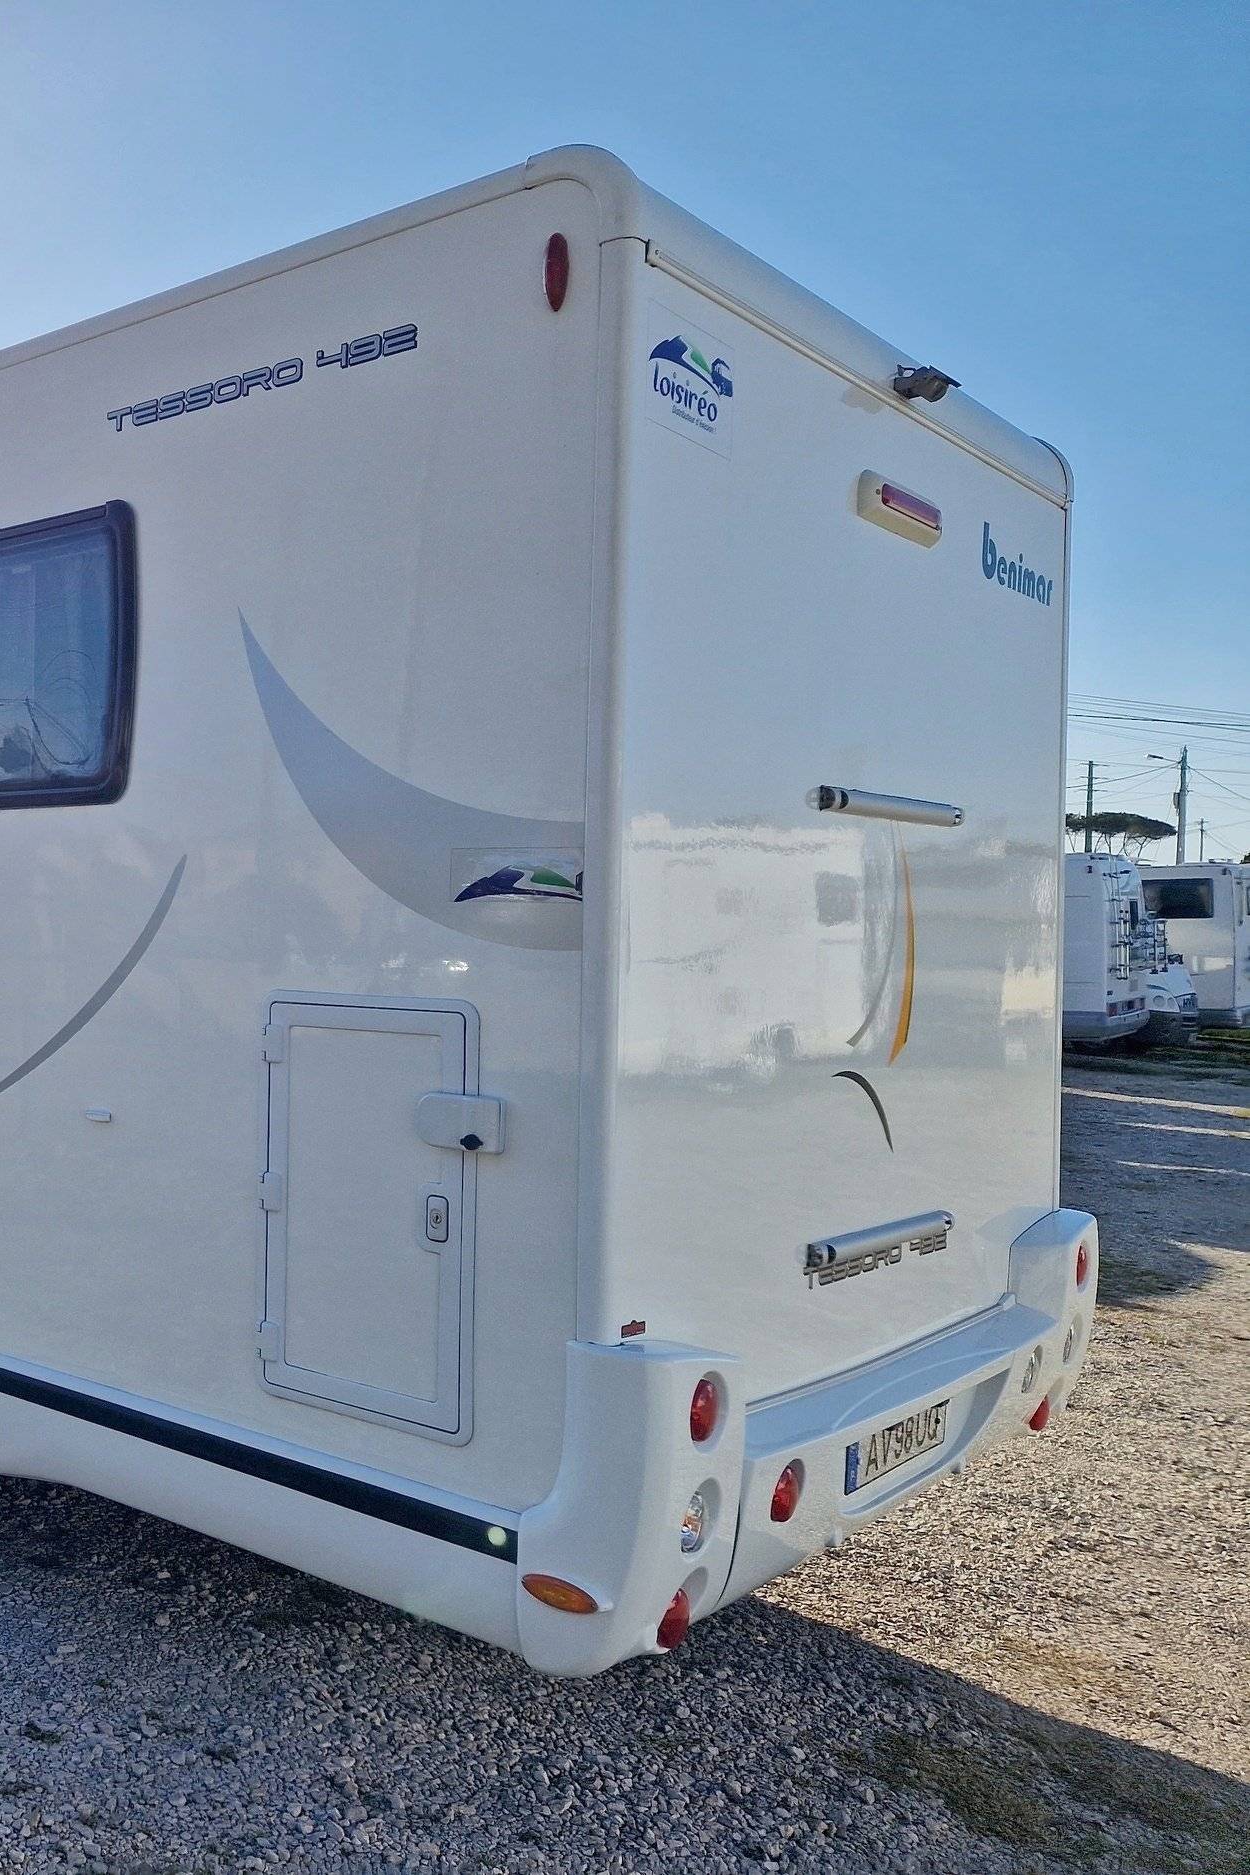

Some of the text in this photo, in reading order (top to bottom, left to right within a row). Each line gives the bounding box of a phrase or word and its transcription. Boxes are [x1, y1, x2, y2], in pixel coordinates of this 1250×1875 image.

[107, 323, 418, 431] TESSORO 492
[982, 521, 1053, 606] benimar
[803, 1246, 902, 1290] TESSORO
